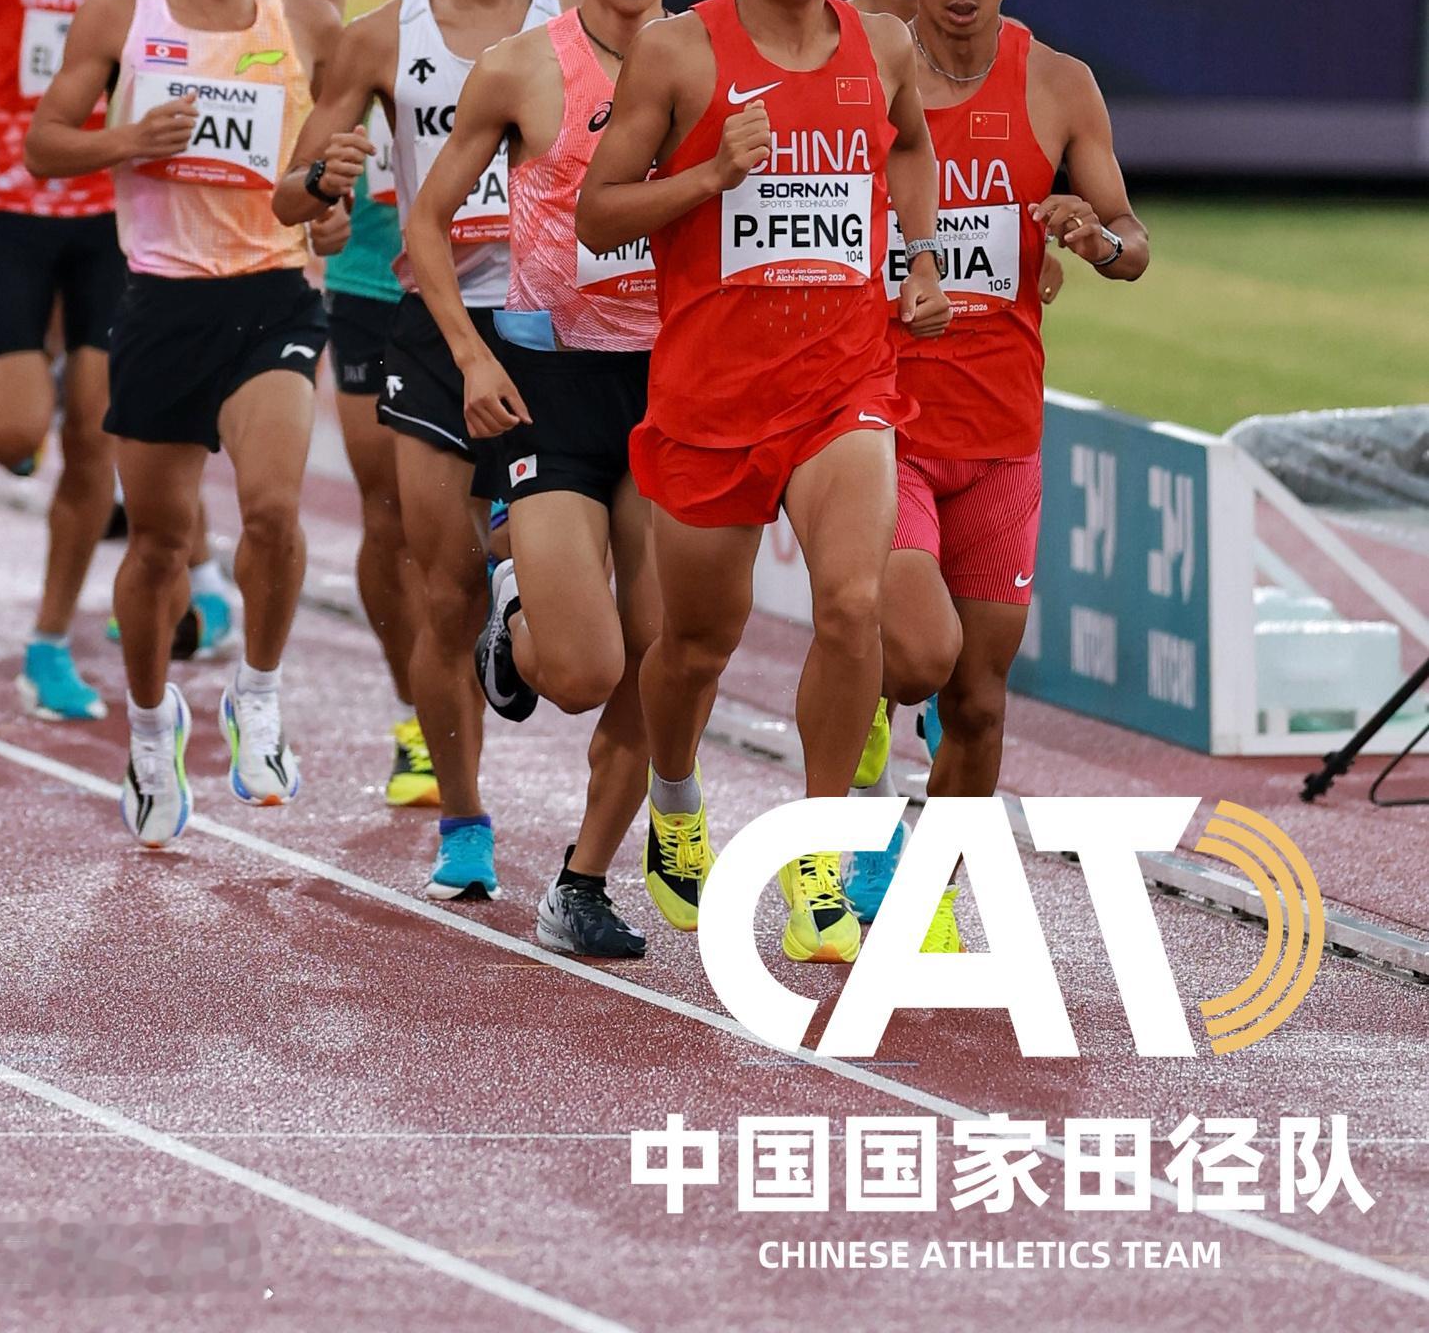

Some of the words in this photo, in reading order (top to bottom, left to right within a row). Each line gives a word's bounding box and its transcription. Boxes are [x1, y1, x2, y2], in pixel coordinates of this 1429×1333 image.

[167, 82, 258, 105] BORNAN
[748, 129, 871, 174] HINA
[247, 155, 270, 167] 106
[757, 182, 849, 199] BORNAN
[759, 200, 792, 209] SPORTS
[795, 199, 849, 209] TECHNOLOGY
[733, 213, 863, 249] P.FENG
[845, 250, 863, 263] 104
[987, 277, 1012, 293] 105
